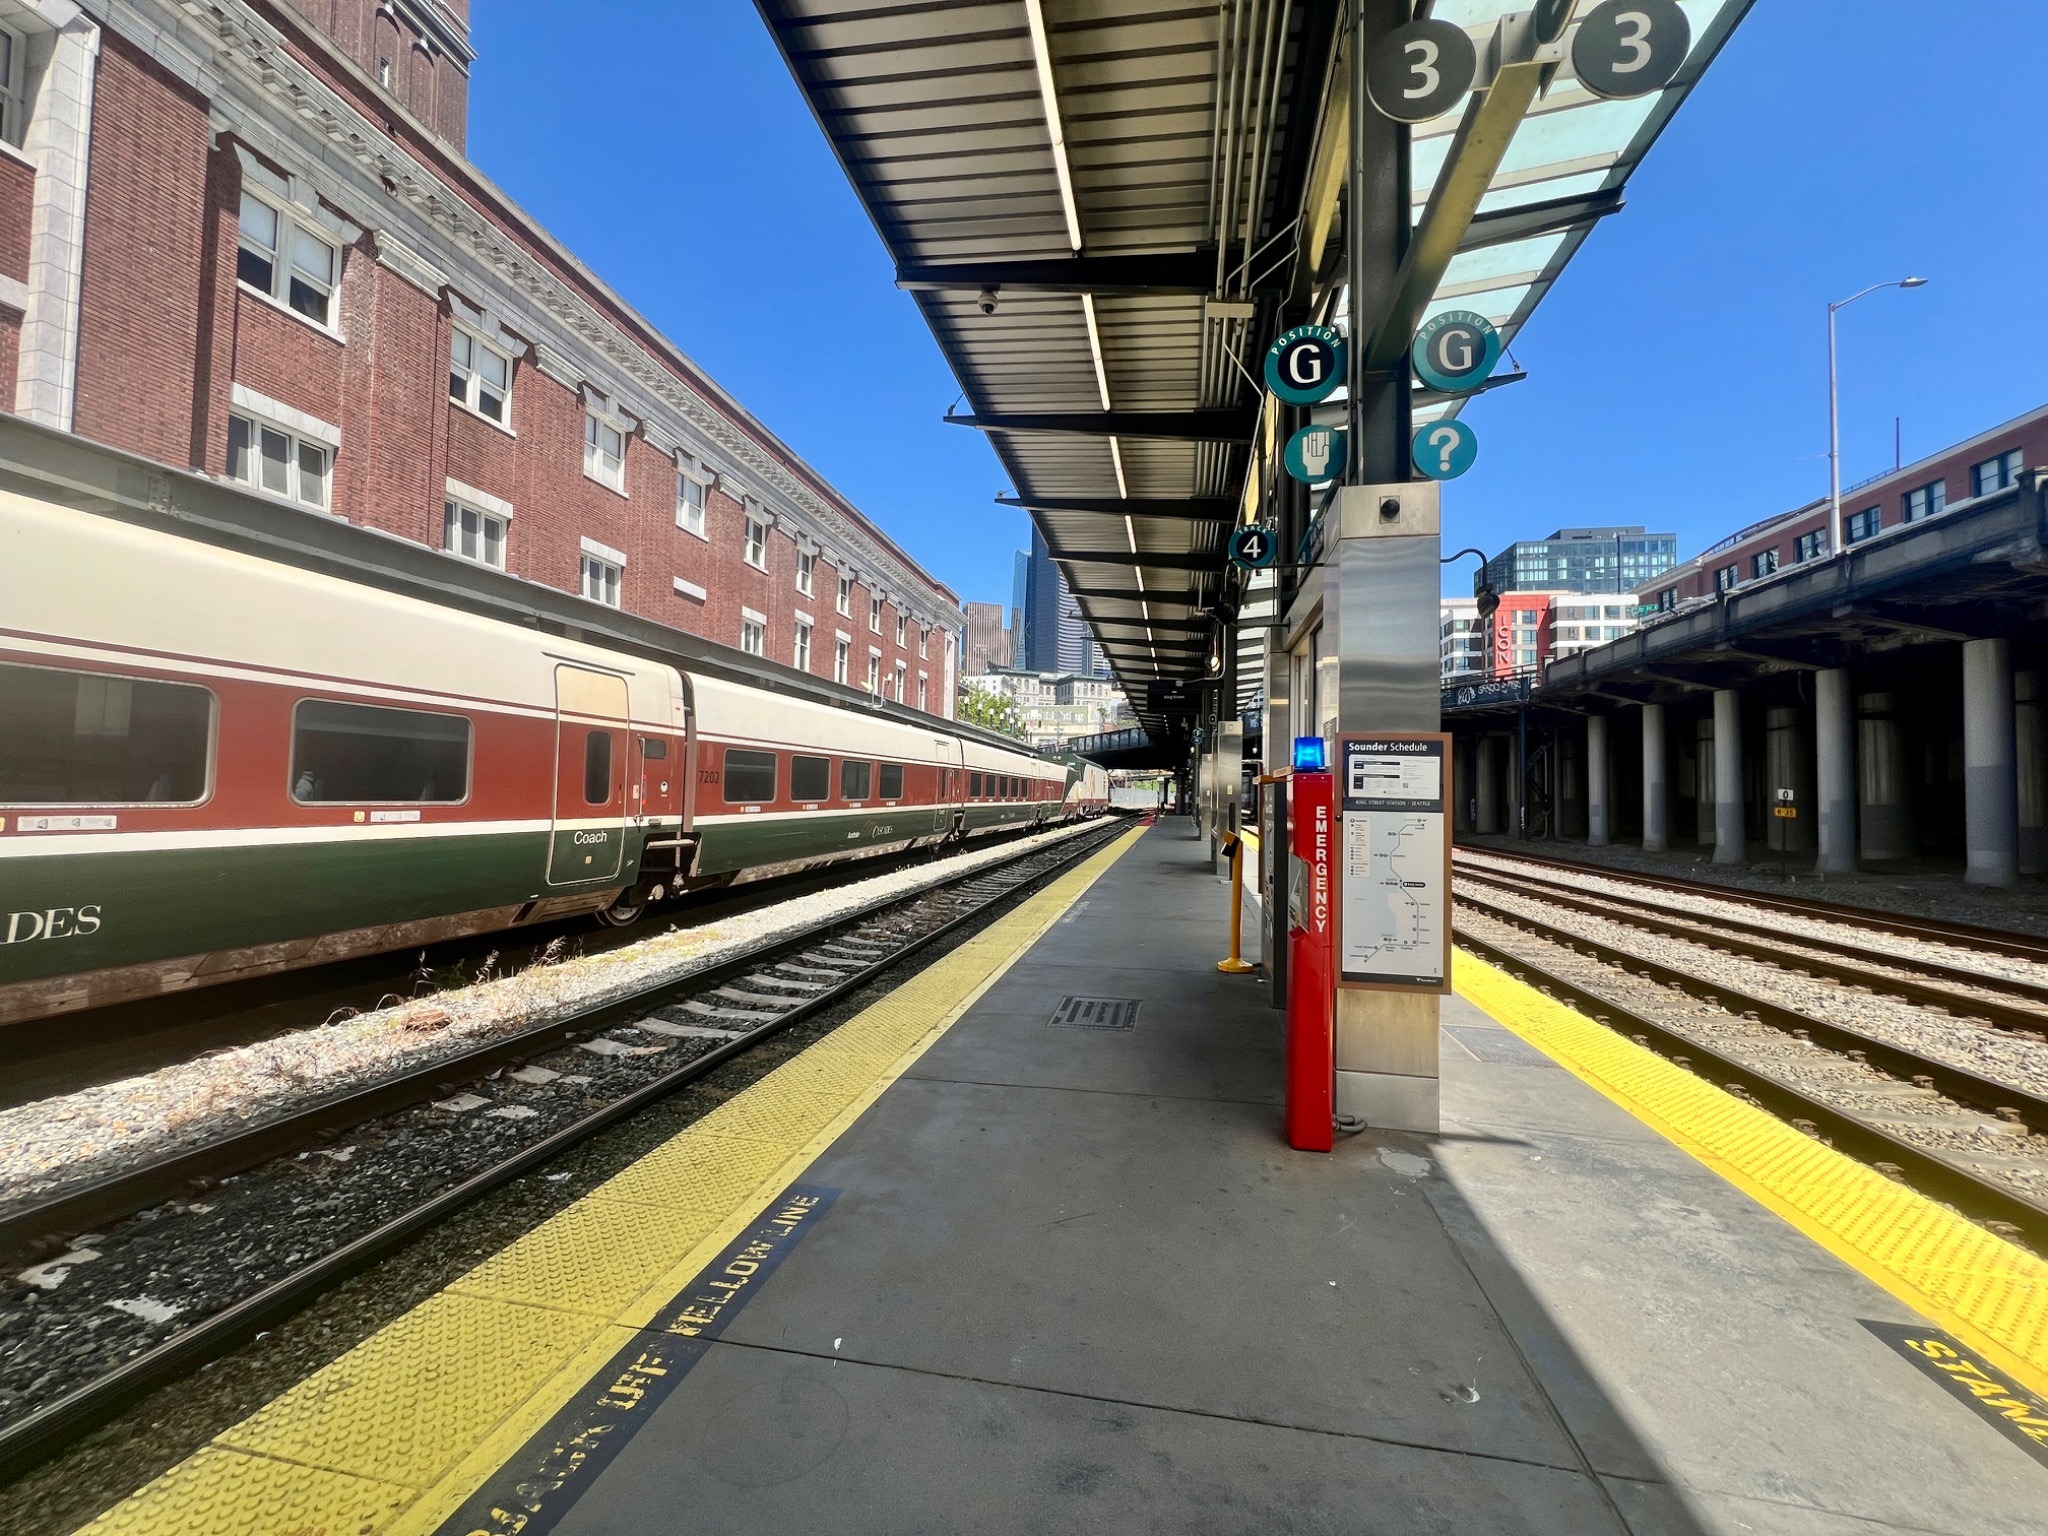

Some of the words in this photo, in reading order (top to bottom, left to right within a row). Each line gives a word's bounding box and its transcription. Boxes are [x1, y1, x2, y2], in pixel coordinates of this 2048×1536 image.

[1611, 11, 1653, 73] 3
[1403, 39, 1441, 99] 3
[1271, 326, 1341, 355] POSITION
[1419, 311, 1494, 340] POSITION
[1289, 343, 1322, 384] G
[1438, 329, 1473, 371] G
[1242, 535, 1262, 559] 4
[1498, 614, 1511, 665] ICON
[1348, 742, 1388, 752] Sounder
[1390, 742, 1428, 752] Schedule
[699, 770, 720, 785] 7202
[574, 830, 608, 845] Coach
[1315, 805, 1328, 934] EMERGENCY
[0, 904, 102, 946] DES
[771, 1194, 820, 1238] LINE
